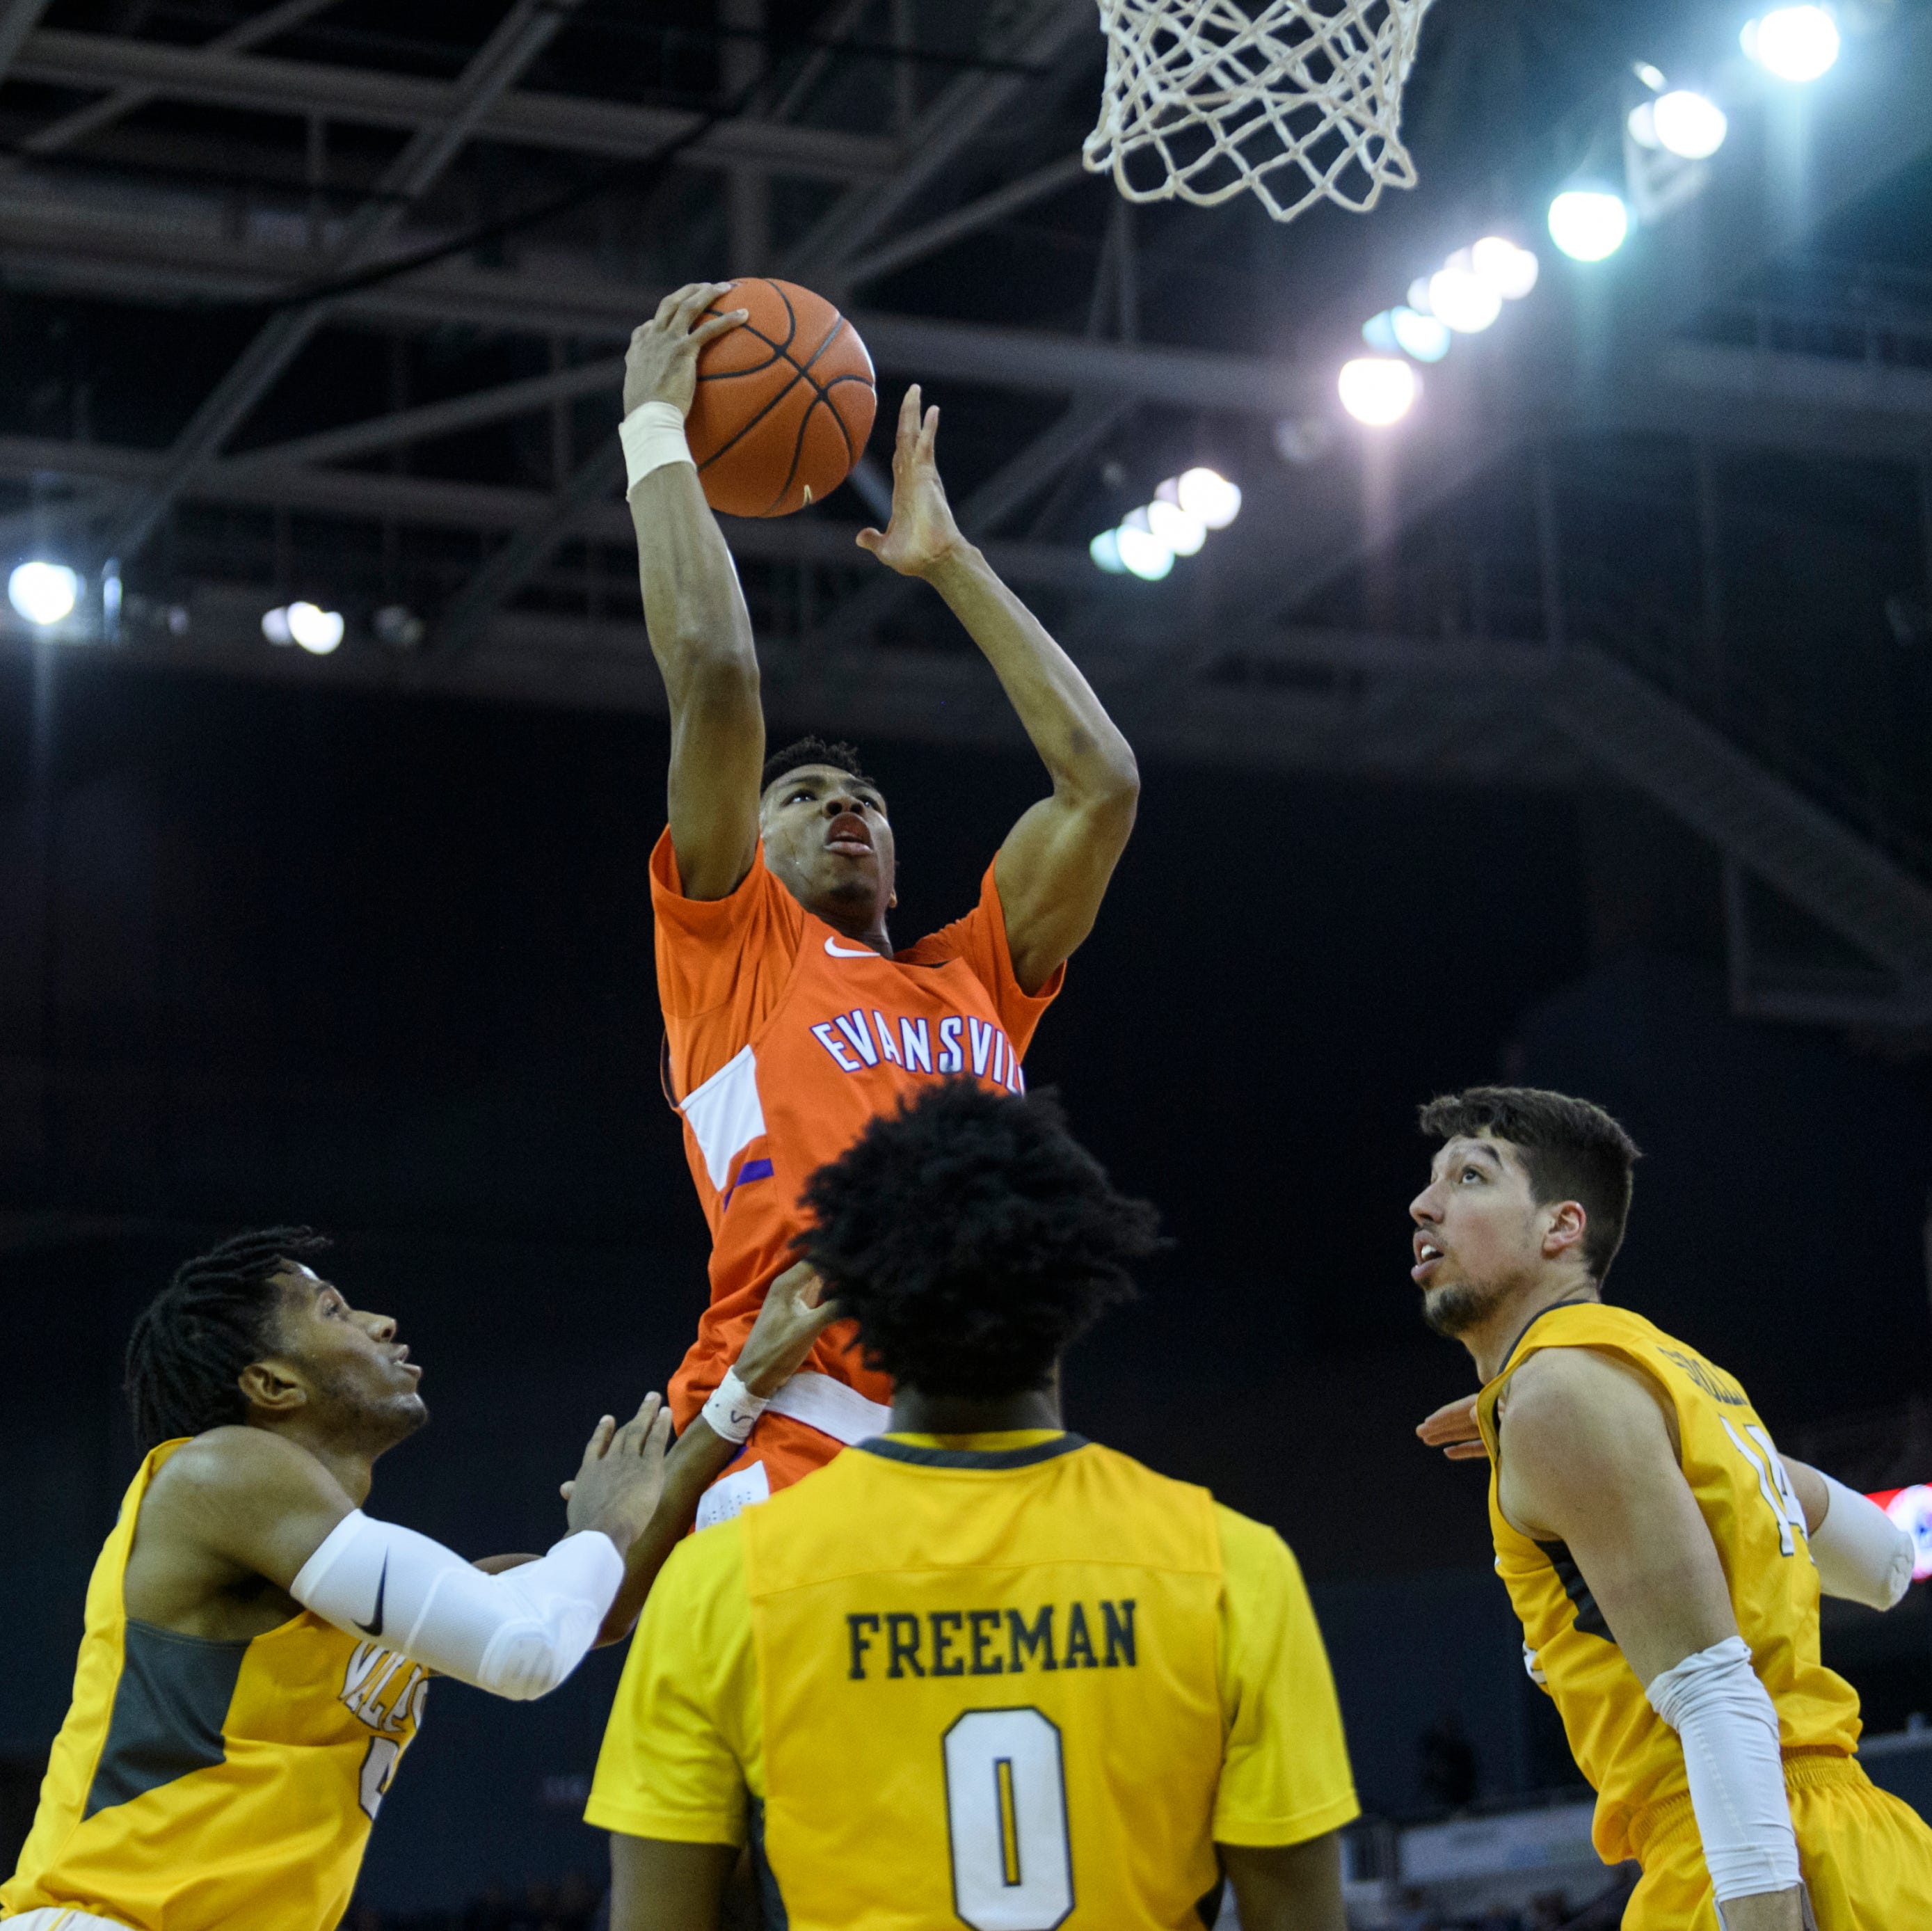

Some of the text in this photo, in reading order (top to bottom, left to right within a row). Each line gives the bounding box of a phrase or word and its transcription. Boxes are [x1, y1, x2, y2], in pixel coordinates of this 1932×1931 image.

[1718, 1414, 1816, 1565] 14
[847, 1598, 1137, 1680] FREEMAN
[941, 1705, 1076, 1931] 0
